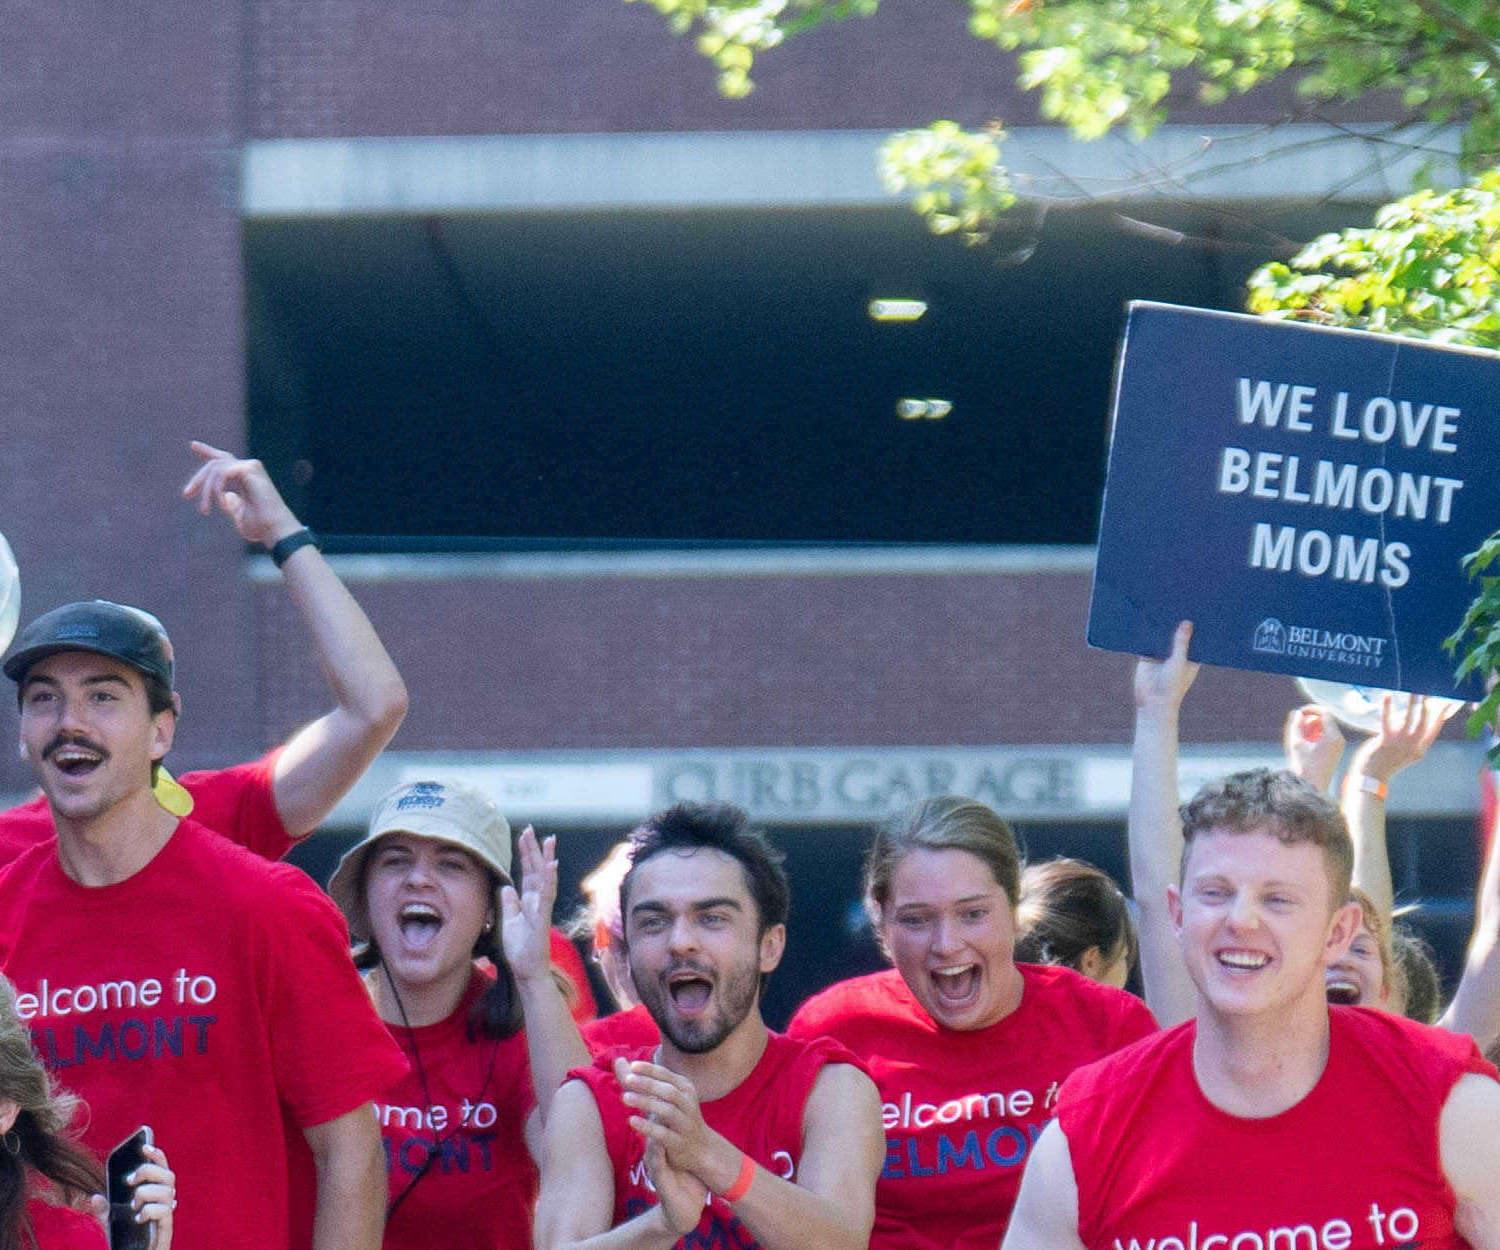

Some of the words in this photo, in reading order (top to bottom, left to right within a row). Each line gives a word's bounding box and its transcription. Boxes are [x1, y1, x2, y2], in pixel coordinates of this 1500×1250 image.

[1238, 377, 1317, 432] WE
[1332, 391, 1461, 453] LOVE
[1219, 446, 1464, 524] BELMONT
[1250, 521, 1412, 588] MOMS
[1286, 646, 1384, 668] UNIVERSITY
[1288, 624, 1388, 655] BELMONT
[664, 759, 821, 808] CURB
[833, 758, 1080, 808] GARAGE
[14, 978, 163, 1020] elcome
[175, 967, 217, 1005] to
[29, 1014, 218, 1068] LMONT
[461, 1097, 498, 1128] to
[881, 1088, 1034, 1129] elcome
[881, 1119, 1053, 1180] ELMO
[1367, 1201, 1420, 1246] to
